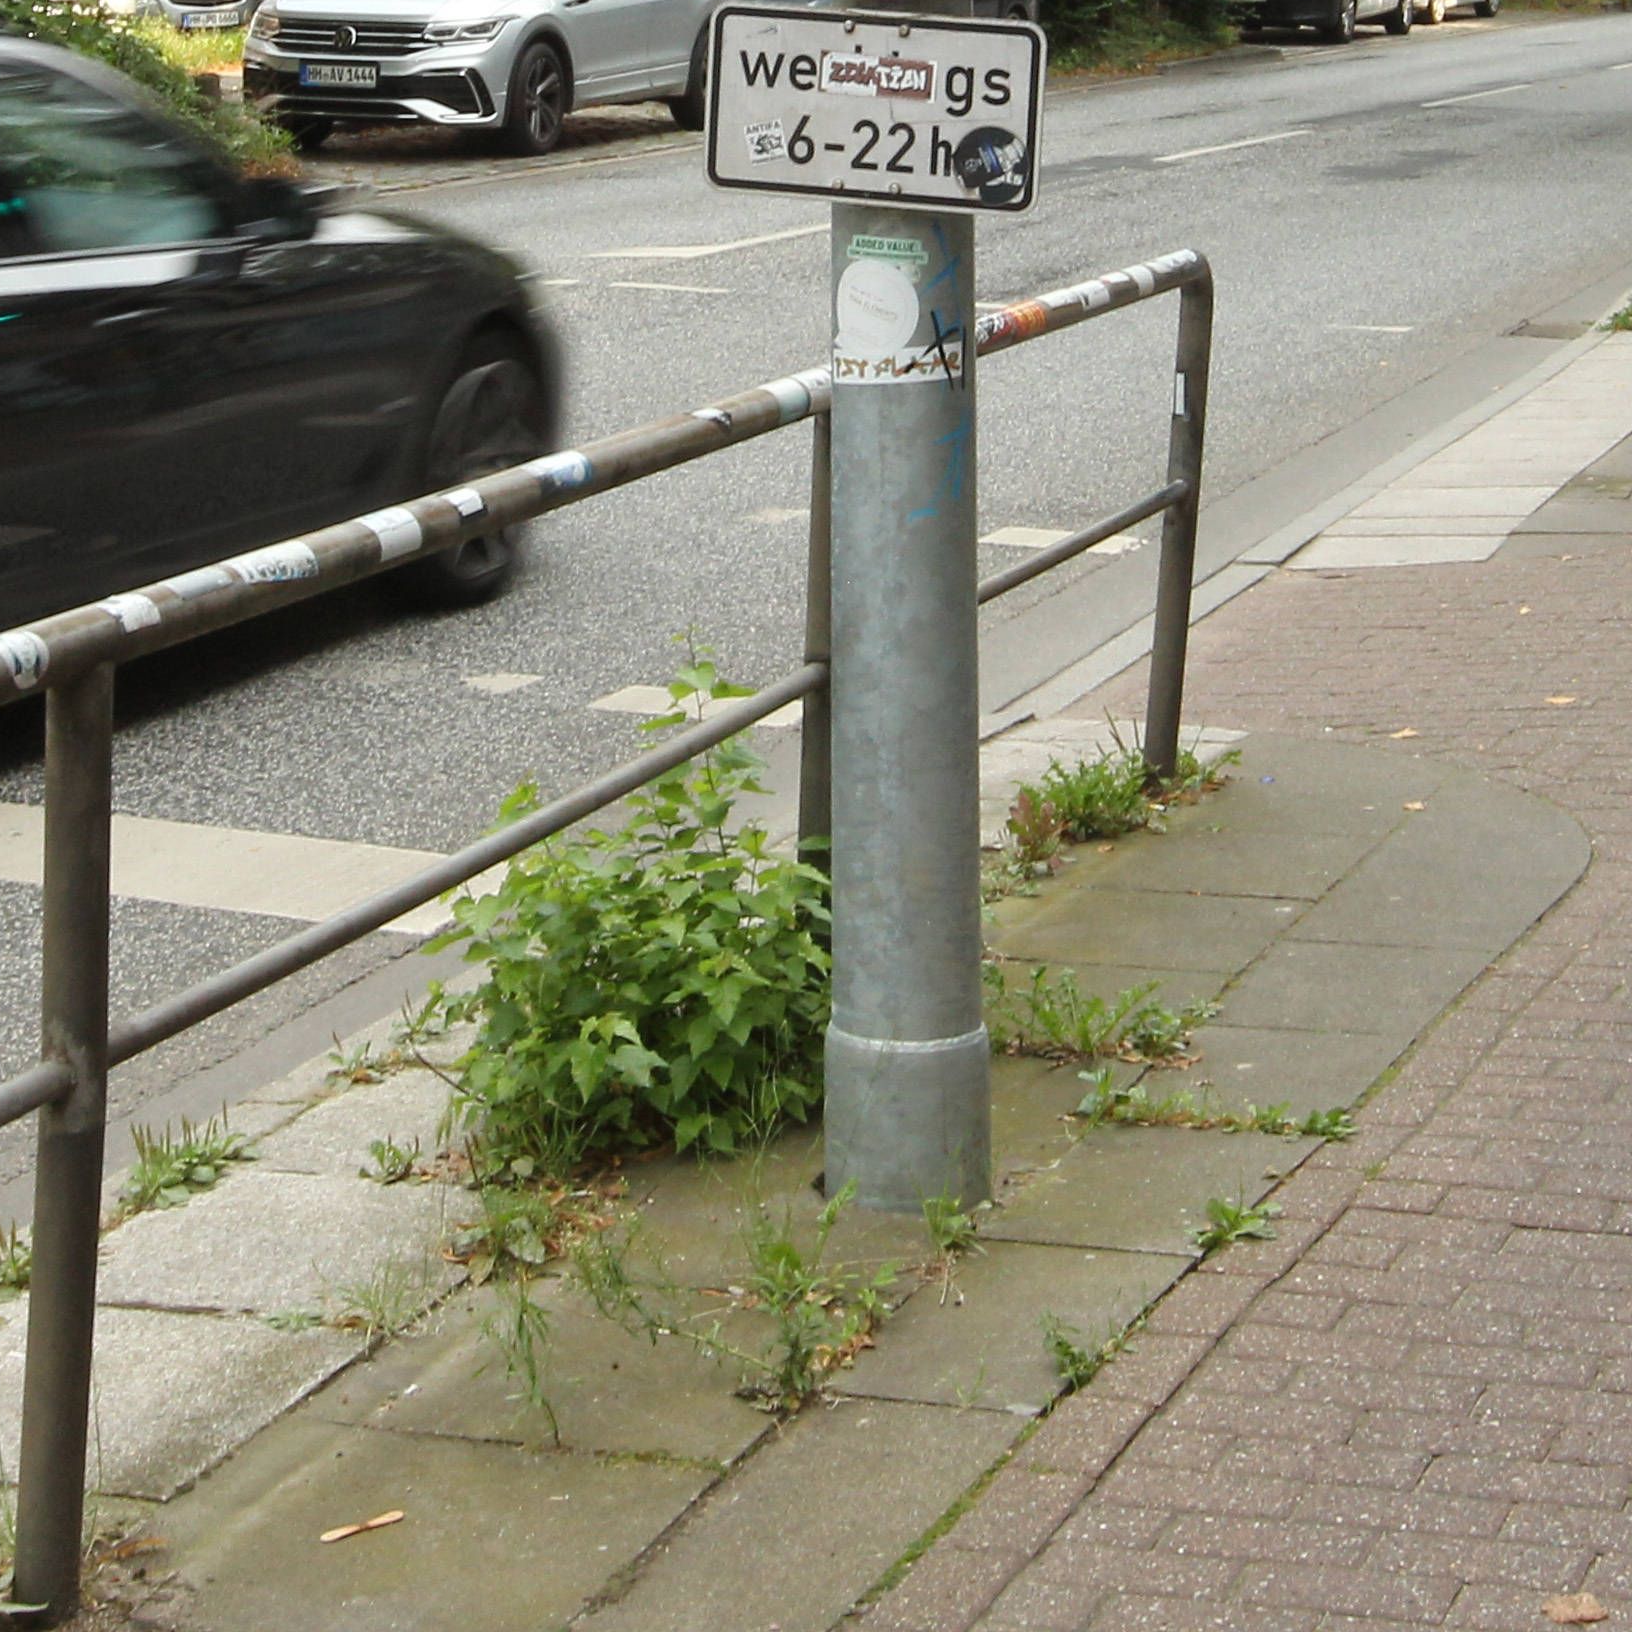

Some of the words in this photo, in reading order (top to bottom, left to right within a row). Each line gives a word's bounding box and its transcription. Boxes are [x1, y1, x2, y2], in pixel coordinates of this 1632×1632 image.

[739, 45, 1013, 117] wegs
[786, 114, 916, 175] 6-22
[930, 125, 952, 177] h
[855, 237, 885, 251] ADDED
